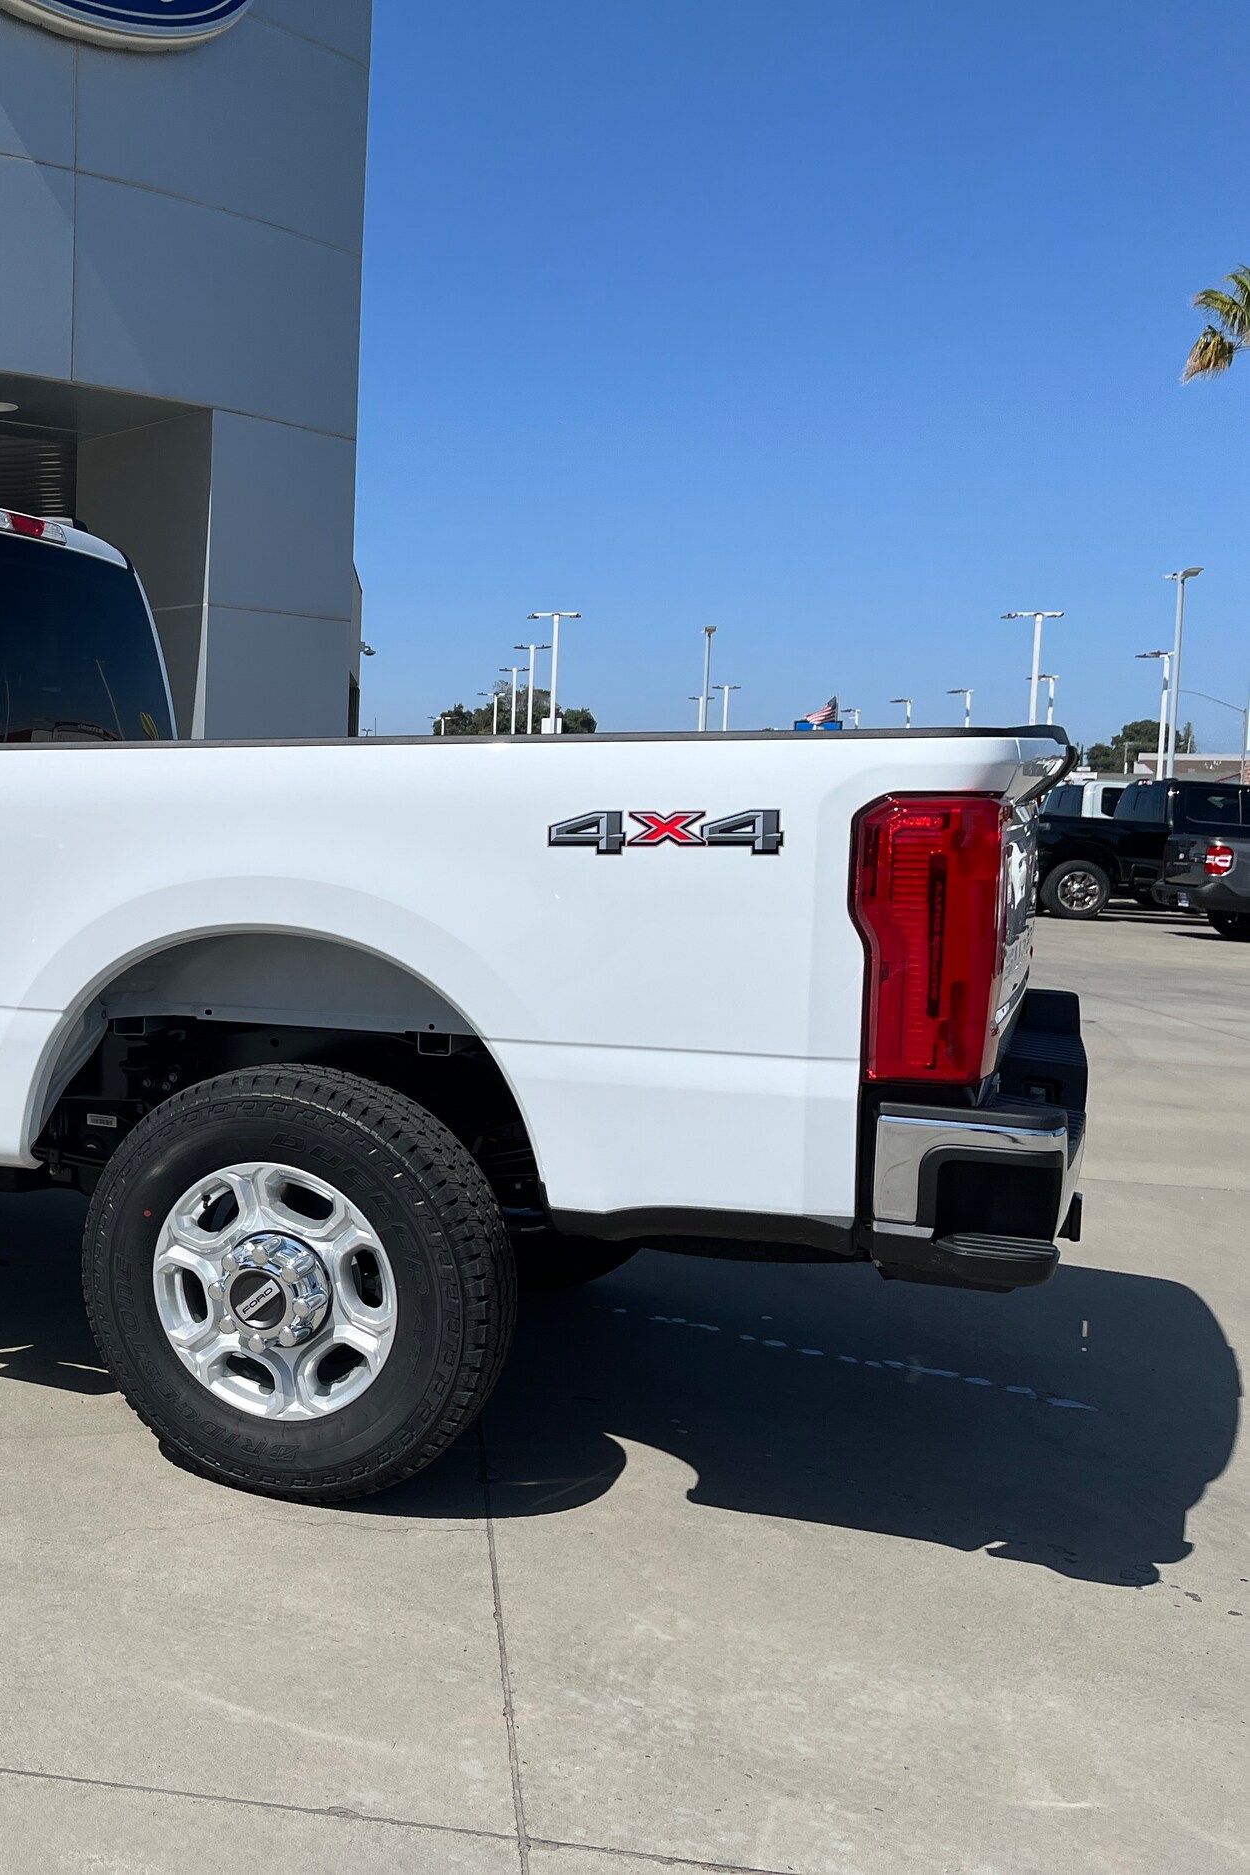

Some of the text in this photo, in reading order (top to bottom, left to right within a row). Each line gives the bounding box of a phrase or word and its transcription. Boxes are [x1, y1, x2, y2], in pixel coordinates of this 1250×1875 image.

[547, 809, 784, 856] 4X4
[933, 881, 942, 932] DUTY
[270, 1132, 429, 1297] DUELER
[242, 1287, 273, 1314] FORD
[115, 1254, 301, 1462] BRIDGESTONE
